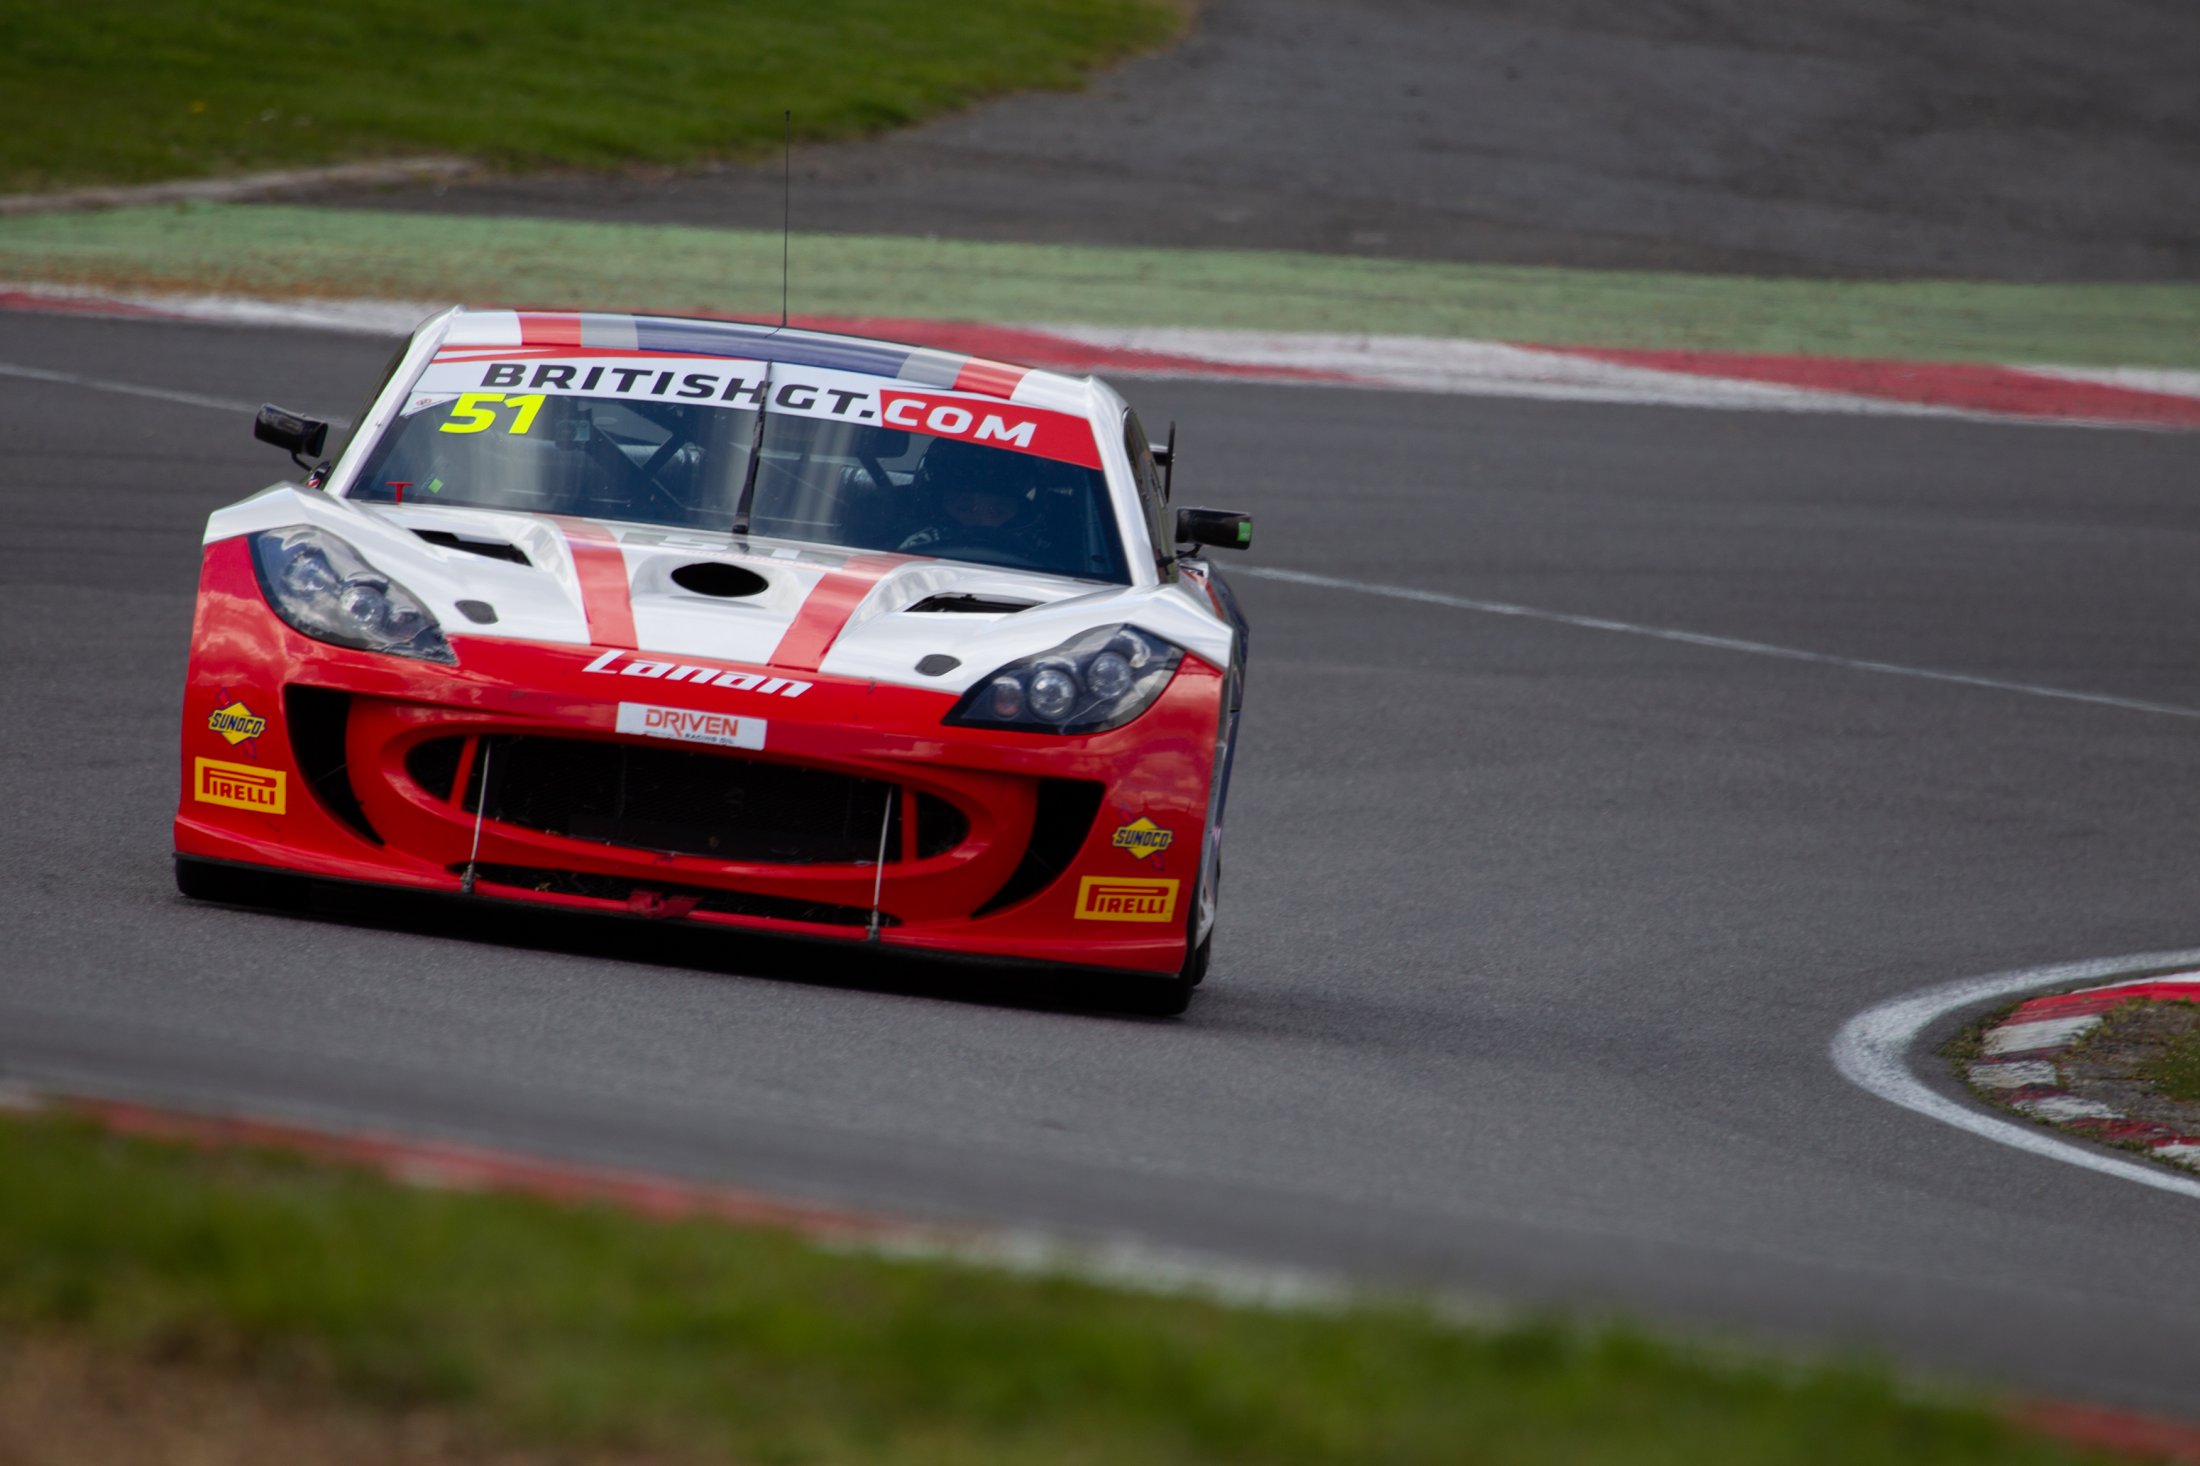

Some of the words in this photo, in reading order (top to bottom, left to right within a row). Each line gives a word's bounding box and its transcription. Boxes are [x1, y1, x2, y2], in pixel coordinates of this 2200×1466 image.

[438, 392, 547, 435] 51
[480, 362, 1038, 449] BRITISHGT.COM
[581, 649, 813, 698] Lanan
[211, 712, 263, 735] SUNOCO
[644, 708, 739, 737] DRIVEN
[202, 766, 277, 805] PIRELLI
[1115, 829, 1169, 847] SUNOCO
[1086, 884, 1169, 914] PIRELLI
